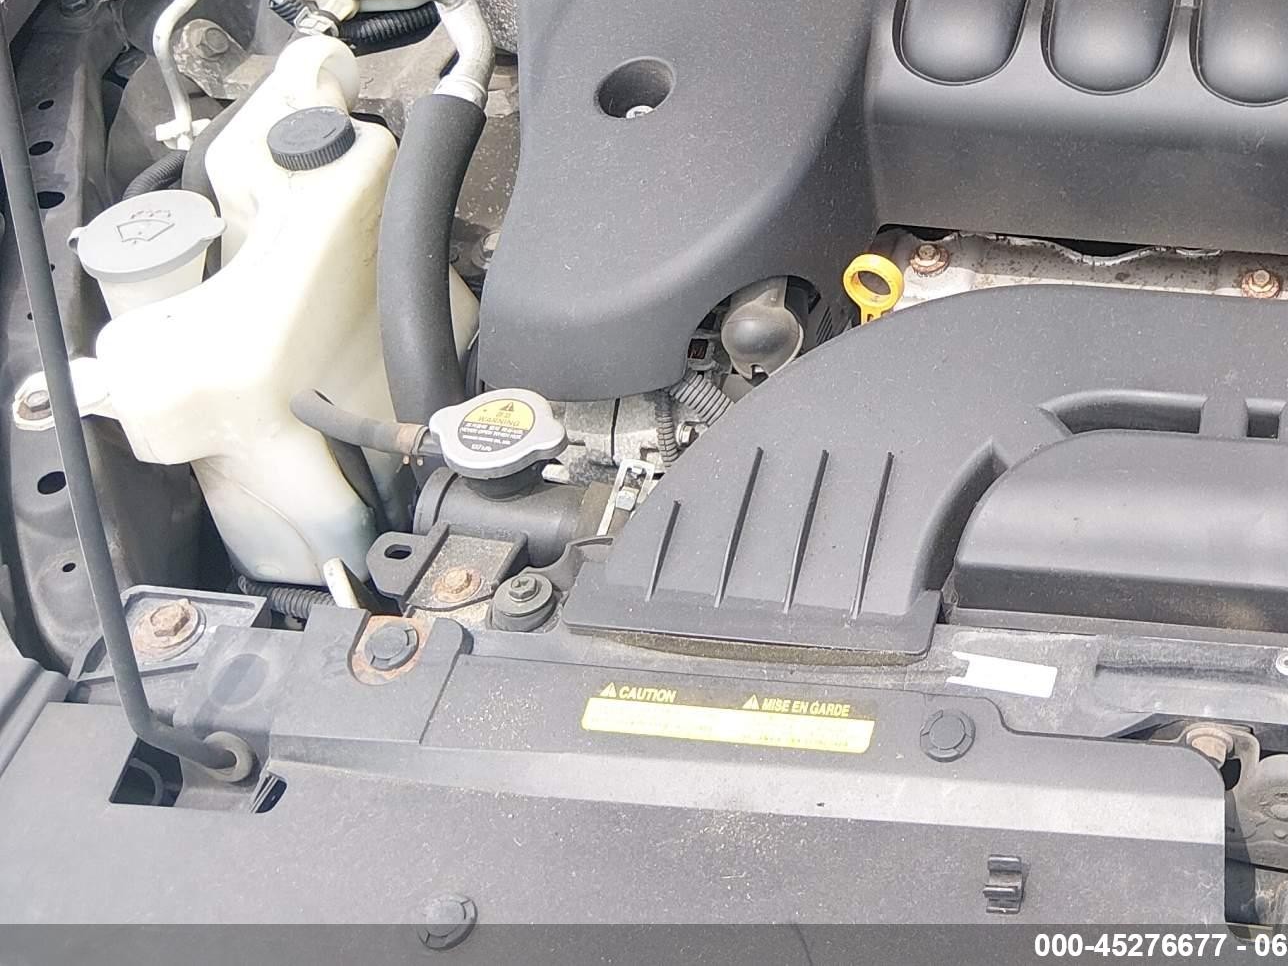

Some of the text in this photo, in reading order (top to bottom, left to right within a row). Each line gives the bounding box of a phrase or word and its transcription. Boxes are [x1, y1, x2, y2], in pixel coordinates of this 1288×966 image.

[618, 685, 677, 703] CAUTION
[761, 698, 851, 717] MISE EN GARDE
